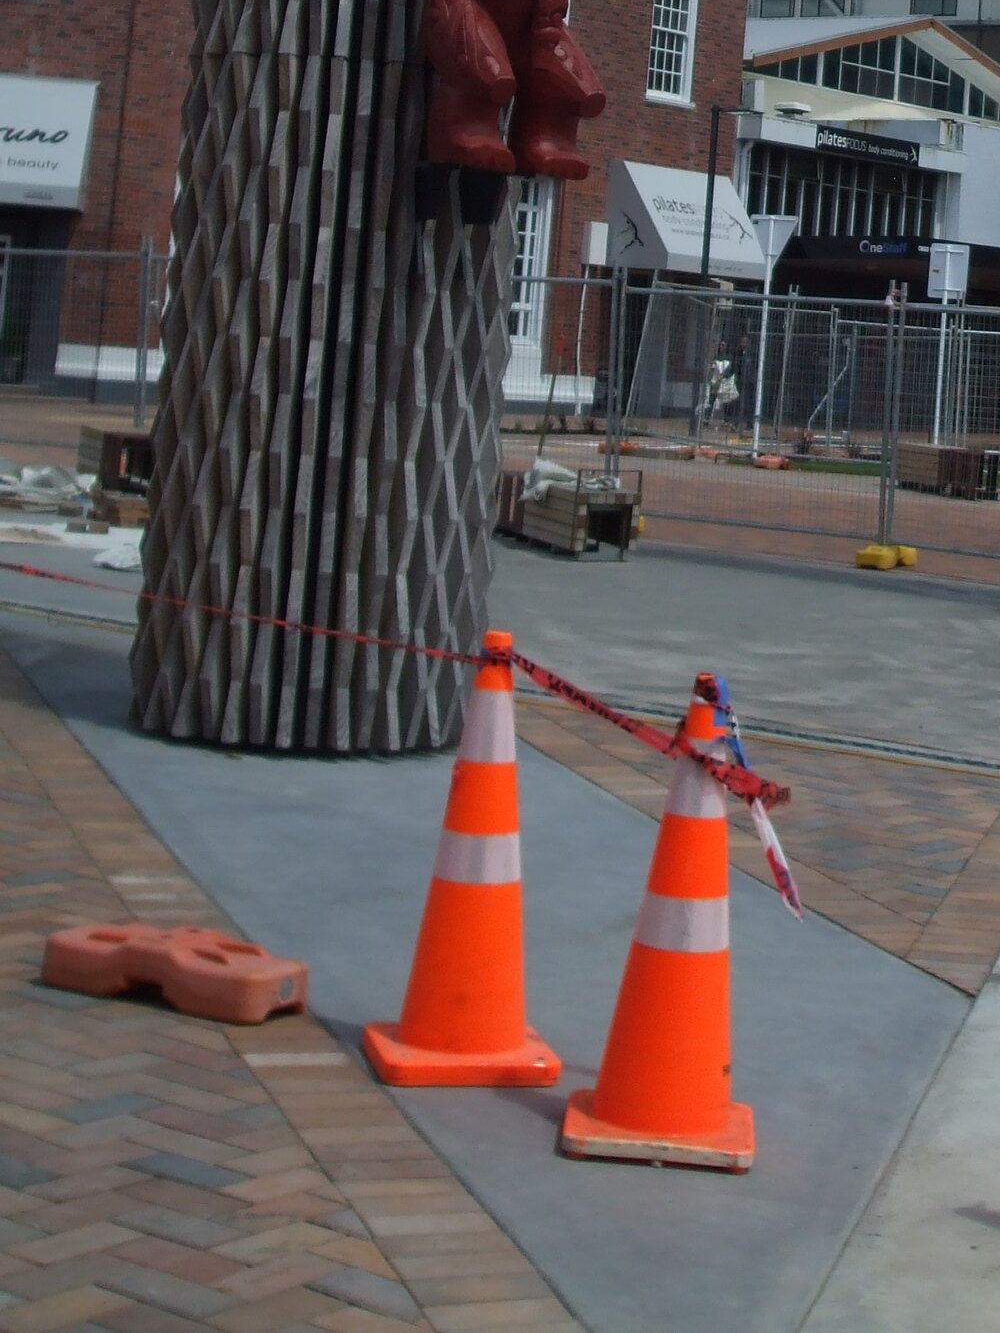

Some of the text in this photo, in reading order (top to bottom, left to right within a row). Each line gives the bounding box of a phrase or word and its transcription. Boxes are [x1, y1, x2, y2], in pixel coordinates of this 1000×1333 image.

[868, 144, 880, 155] body
[880, 147, 909, 160] conditioning
[7, 156, 59, 171] beauty
[859, 240, 908, 254] OneStaff
